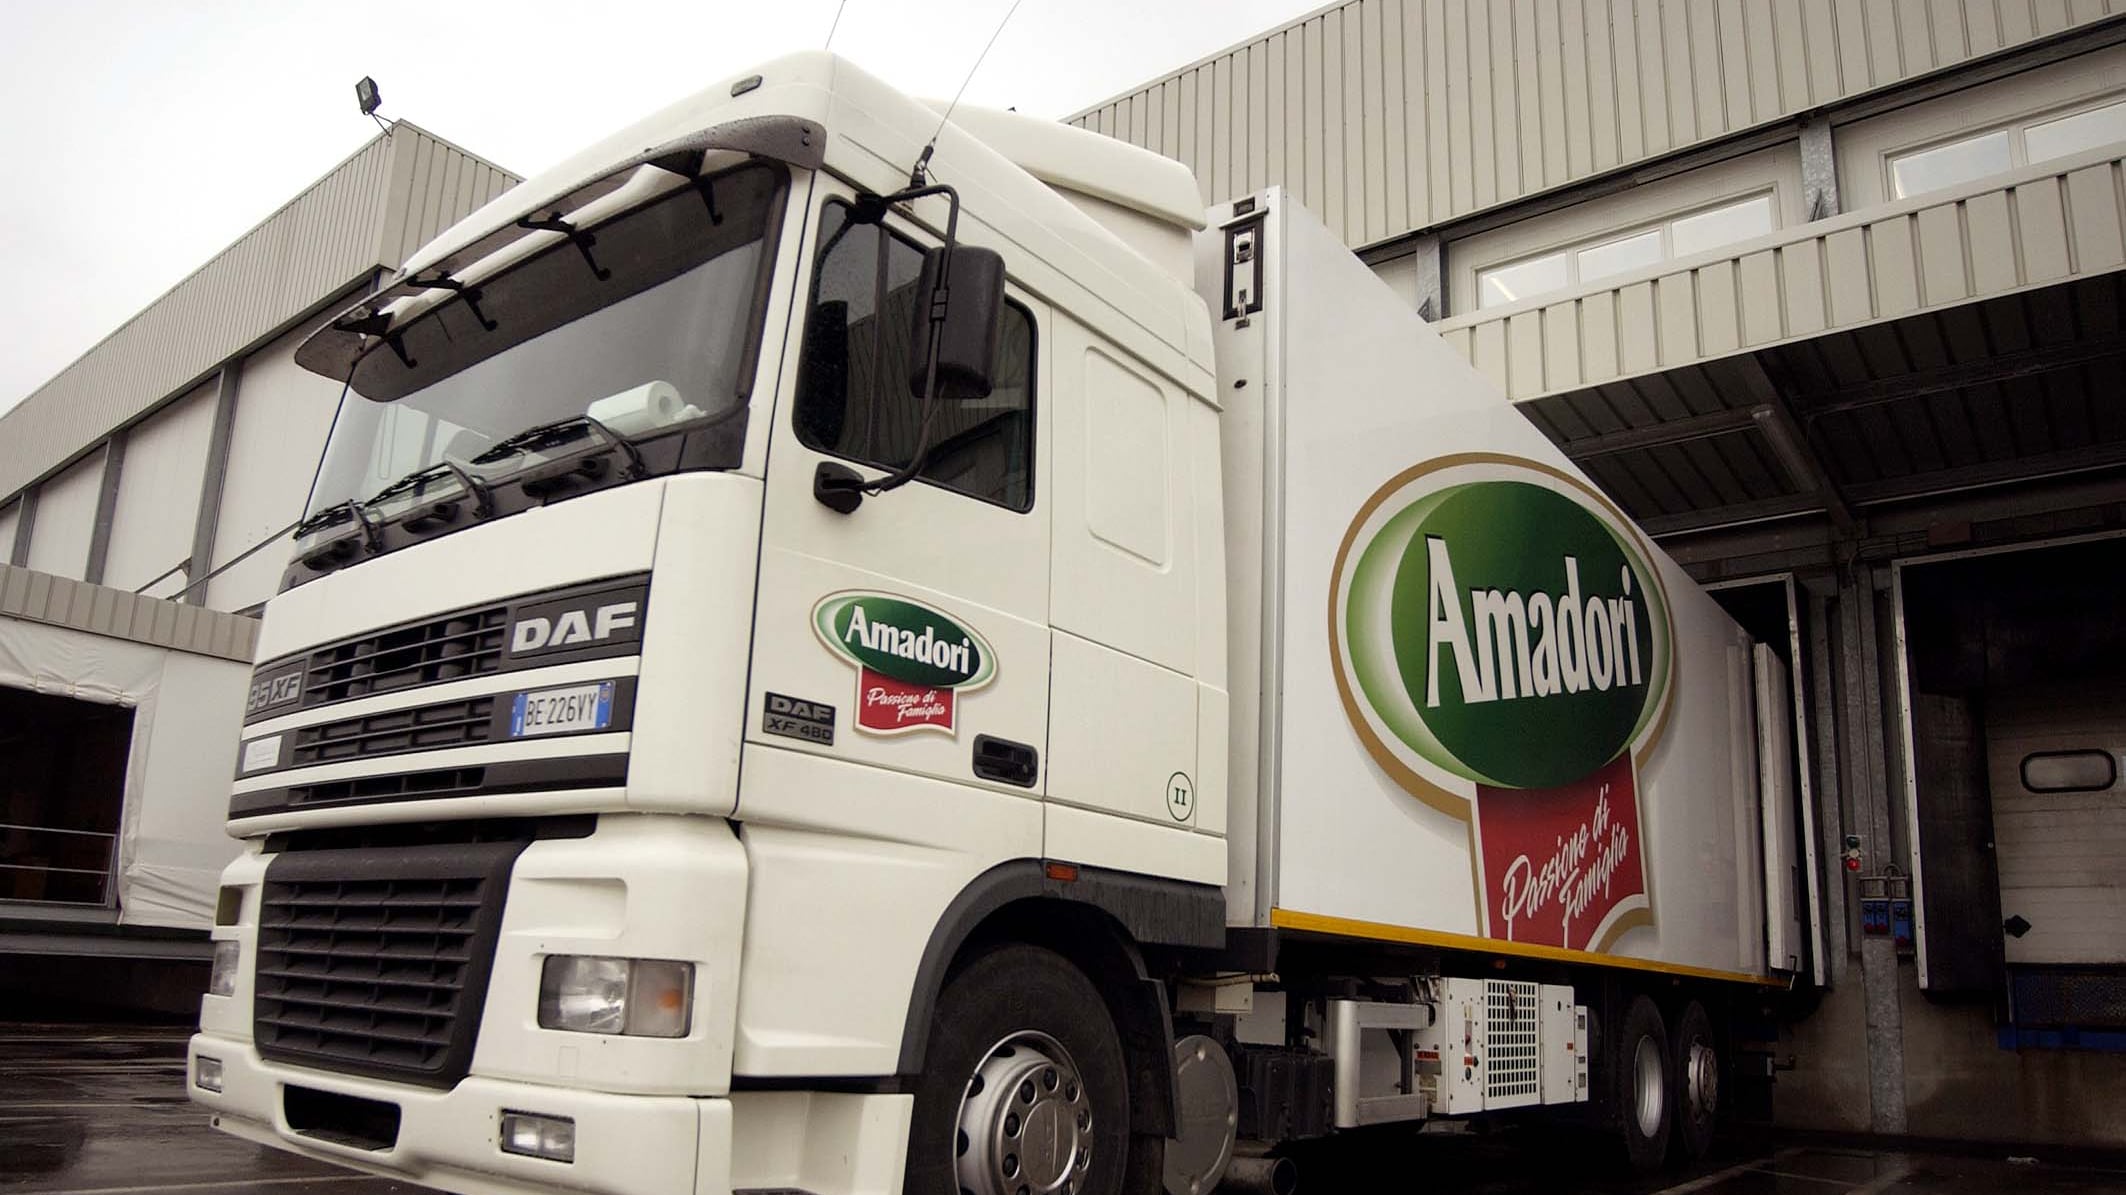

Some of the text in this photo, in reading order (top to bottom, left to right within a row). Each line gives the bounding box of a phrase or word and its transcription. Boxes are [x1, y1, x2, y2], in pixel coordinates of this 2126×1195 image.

[511, 602, 637, 653] DAF
[845, 605, 970, 674] Amadori
[1426, 535, 1641, 708] Amadori
[770, 696, 832, 720] DAF
[867, 687, 937, 707] Passione di
[897, 703, 945, 722] Famiglia
[767, 718, 798, 732] XF
[1502, 783, 1611, 941] Passione di
[1559, 822, 1629, 949] Famiglia
